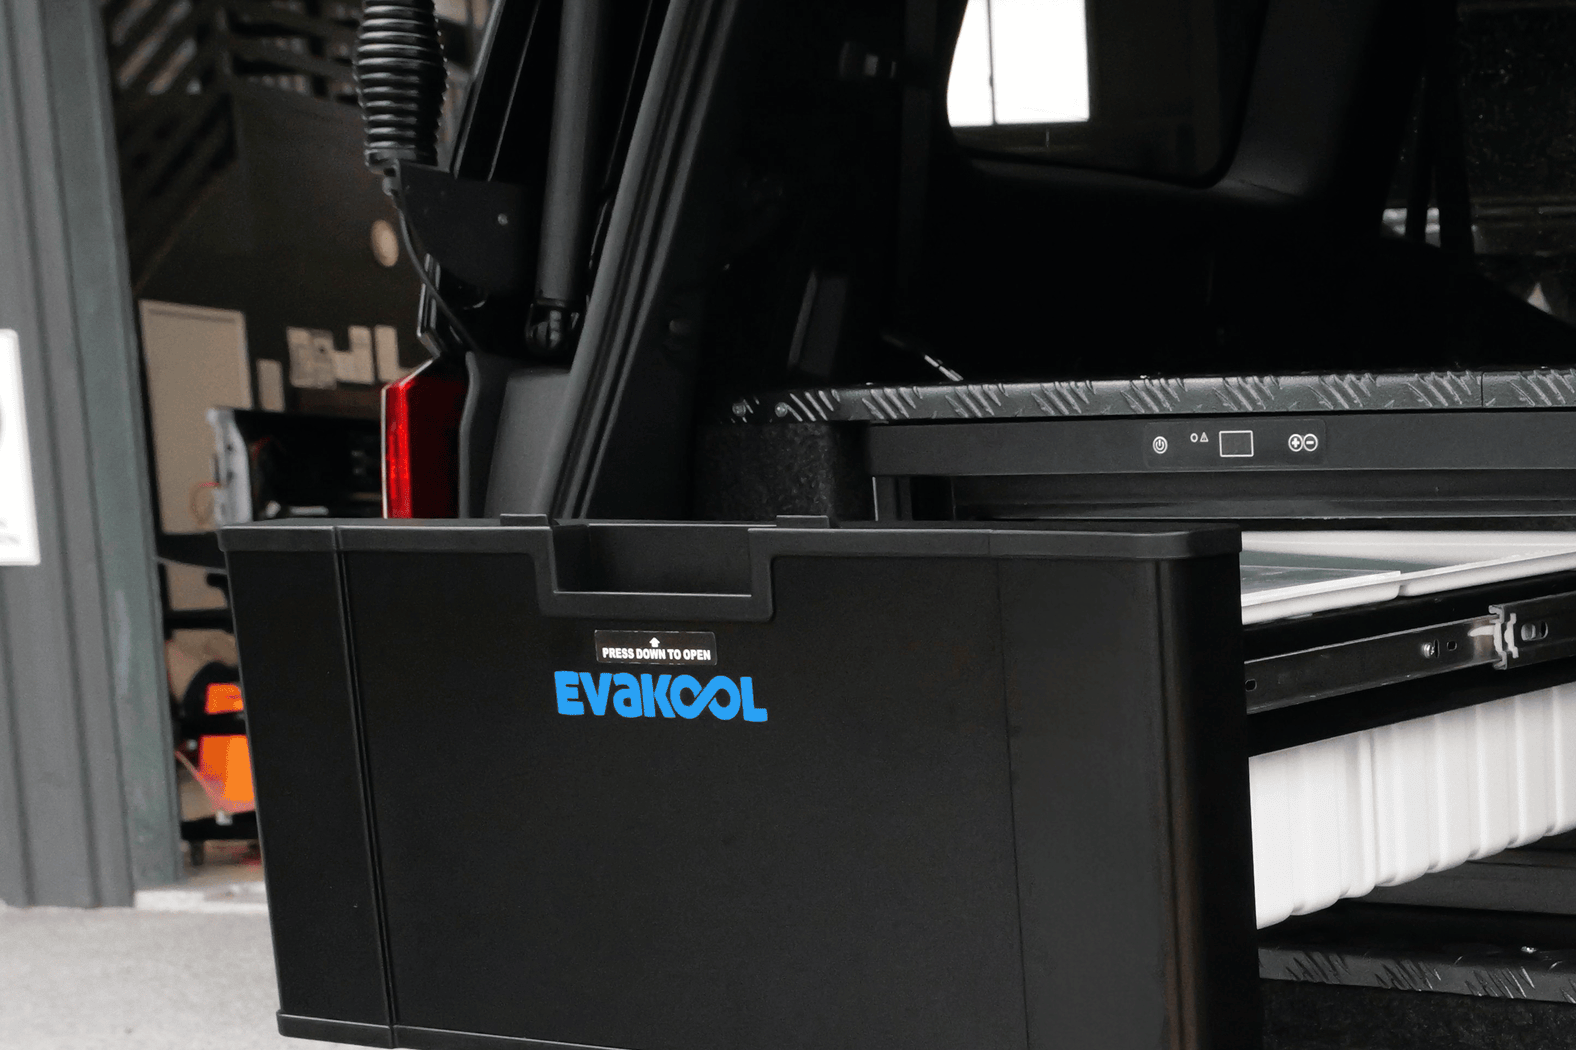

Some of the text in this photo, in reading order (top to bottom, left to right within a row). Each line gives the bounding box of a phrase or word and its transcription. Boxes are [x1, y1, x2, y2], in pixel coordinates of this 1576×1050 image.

[602, 647, 711, 661] PRESS DOWN TO OPEN
